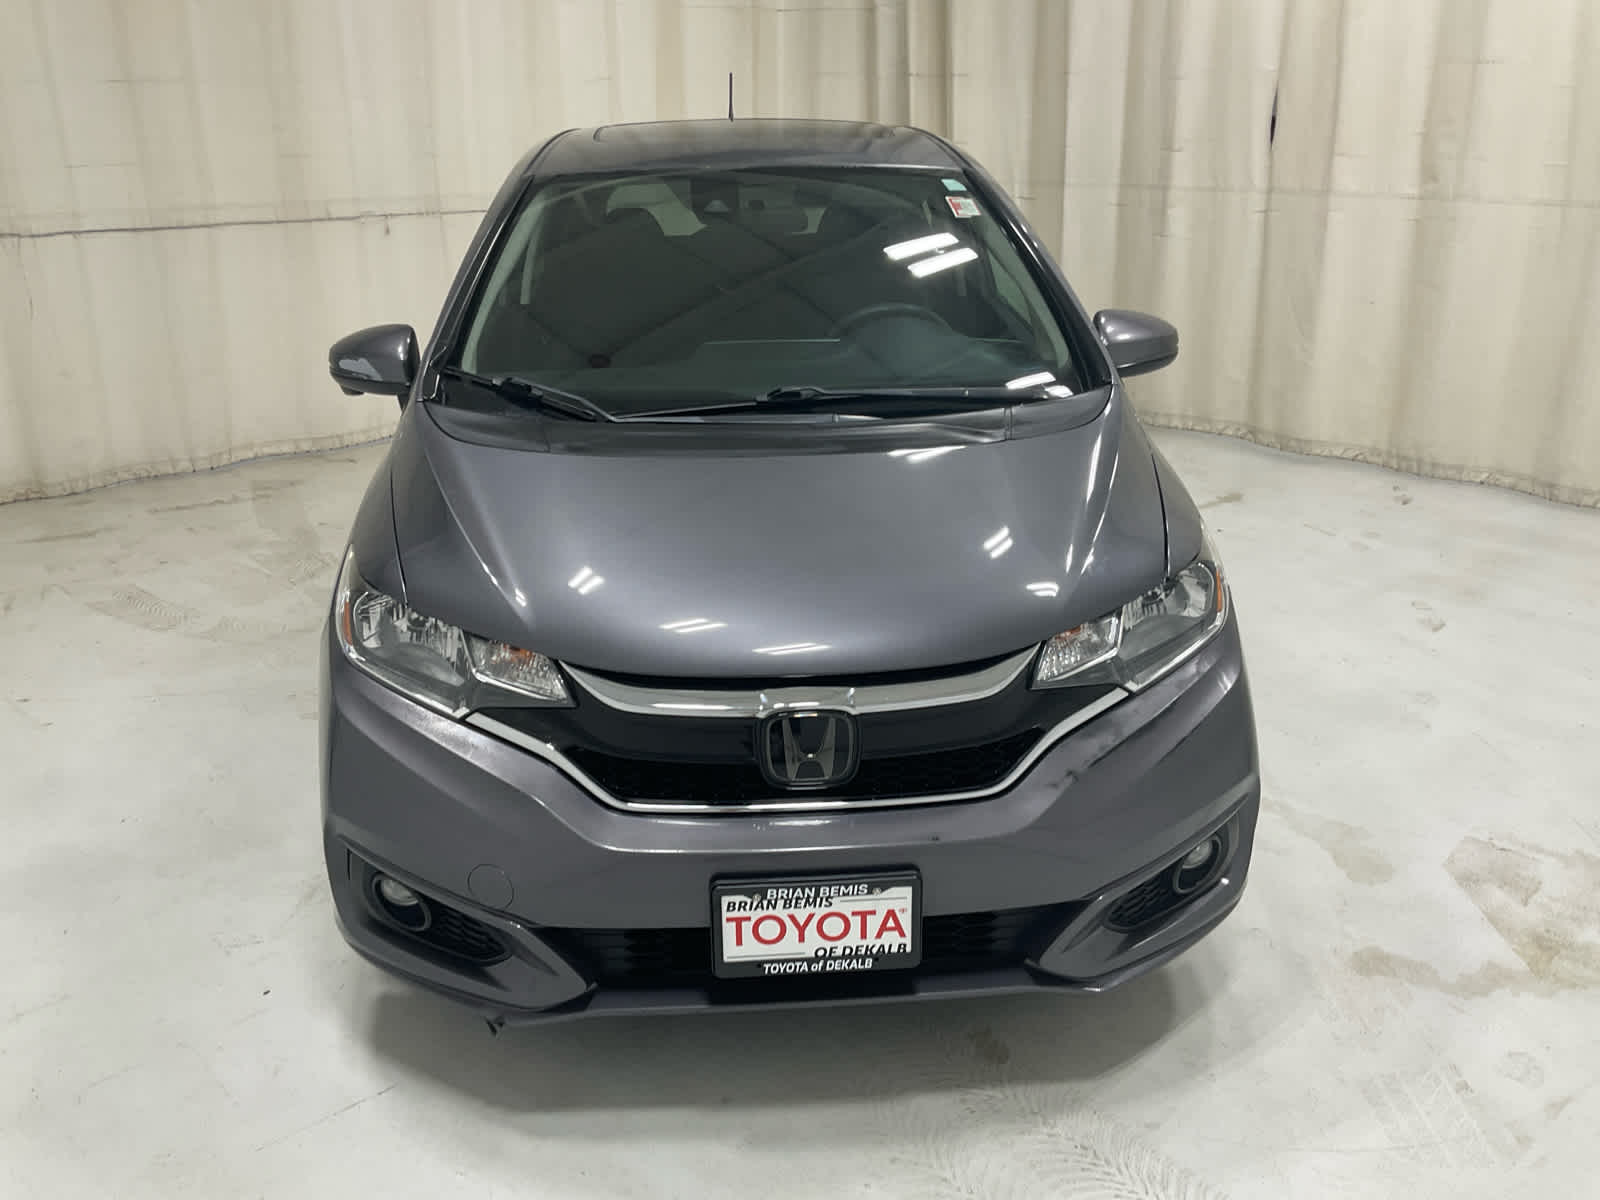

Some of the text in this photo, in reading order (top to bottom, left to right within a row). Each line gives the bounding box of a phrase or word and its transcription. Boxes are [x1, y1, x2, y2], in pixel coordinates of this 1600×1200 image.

[766, 884, 868, 900] BRIAN BEMIS
[726, 897, 834, 912] BRIAN BEMIS
[726, 909, 907, 947] TOYOTA
[814, 943, 907, 958] OF DEKALB
[763, 958, 873, 975] TOYOTA of DEKALB
